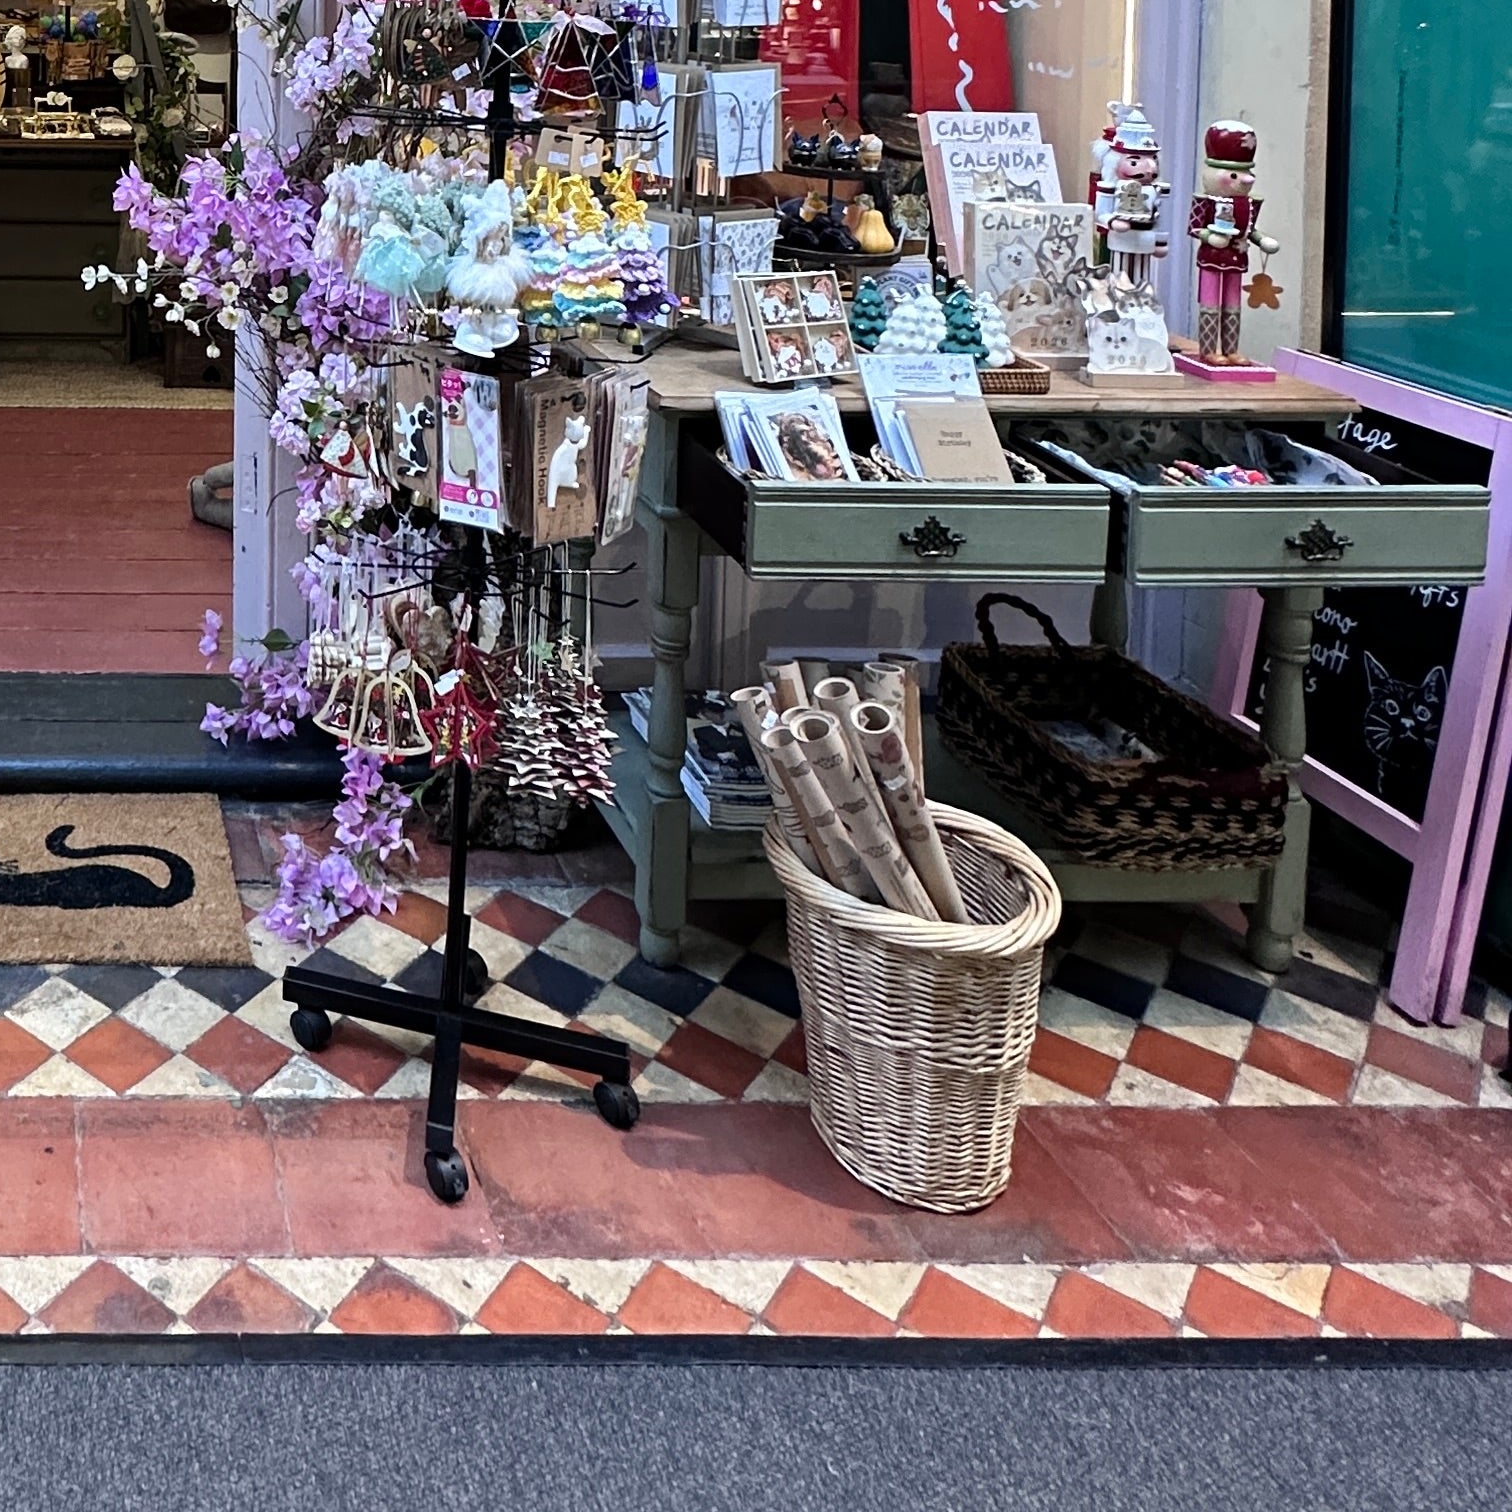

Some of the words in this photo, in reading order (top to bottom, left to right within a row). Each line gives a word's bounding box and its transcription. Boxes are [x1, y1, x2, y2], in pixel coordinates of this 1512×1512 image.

[936, 120, 1032, 138] CALENDAR
[949, 151, 1047, 170] CALENDAR
[982, 213, 1085, 233] CALENDAR
[537, 398, 549, 464] Magnetic
[1337, 412, 1398, 454] tage
[537, 467, 548, 505] Hook
